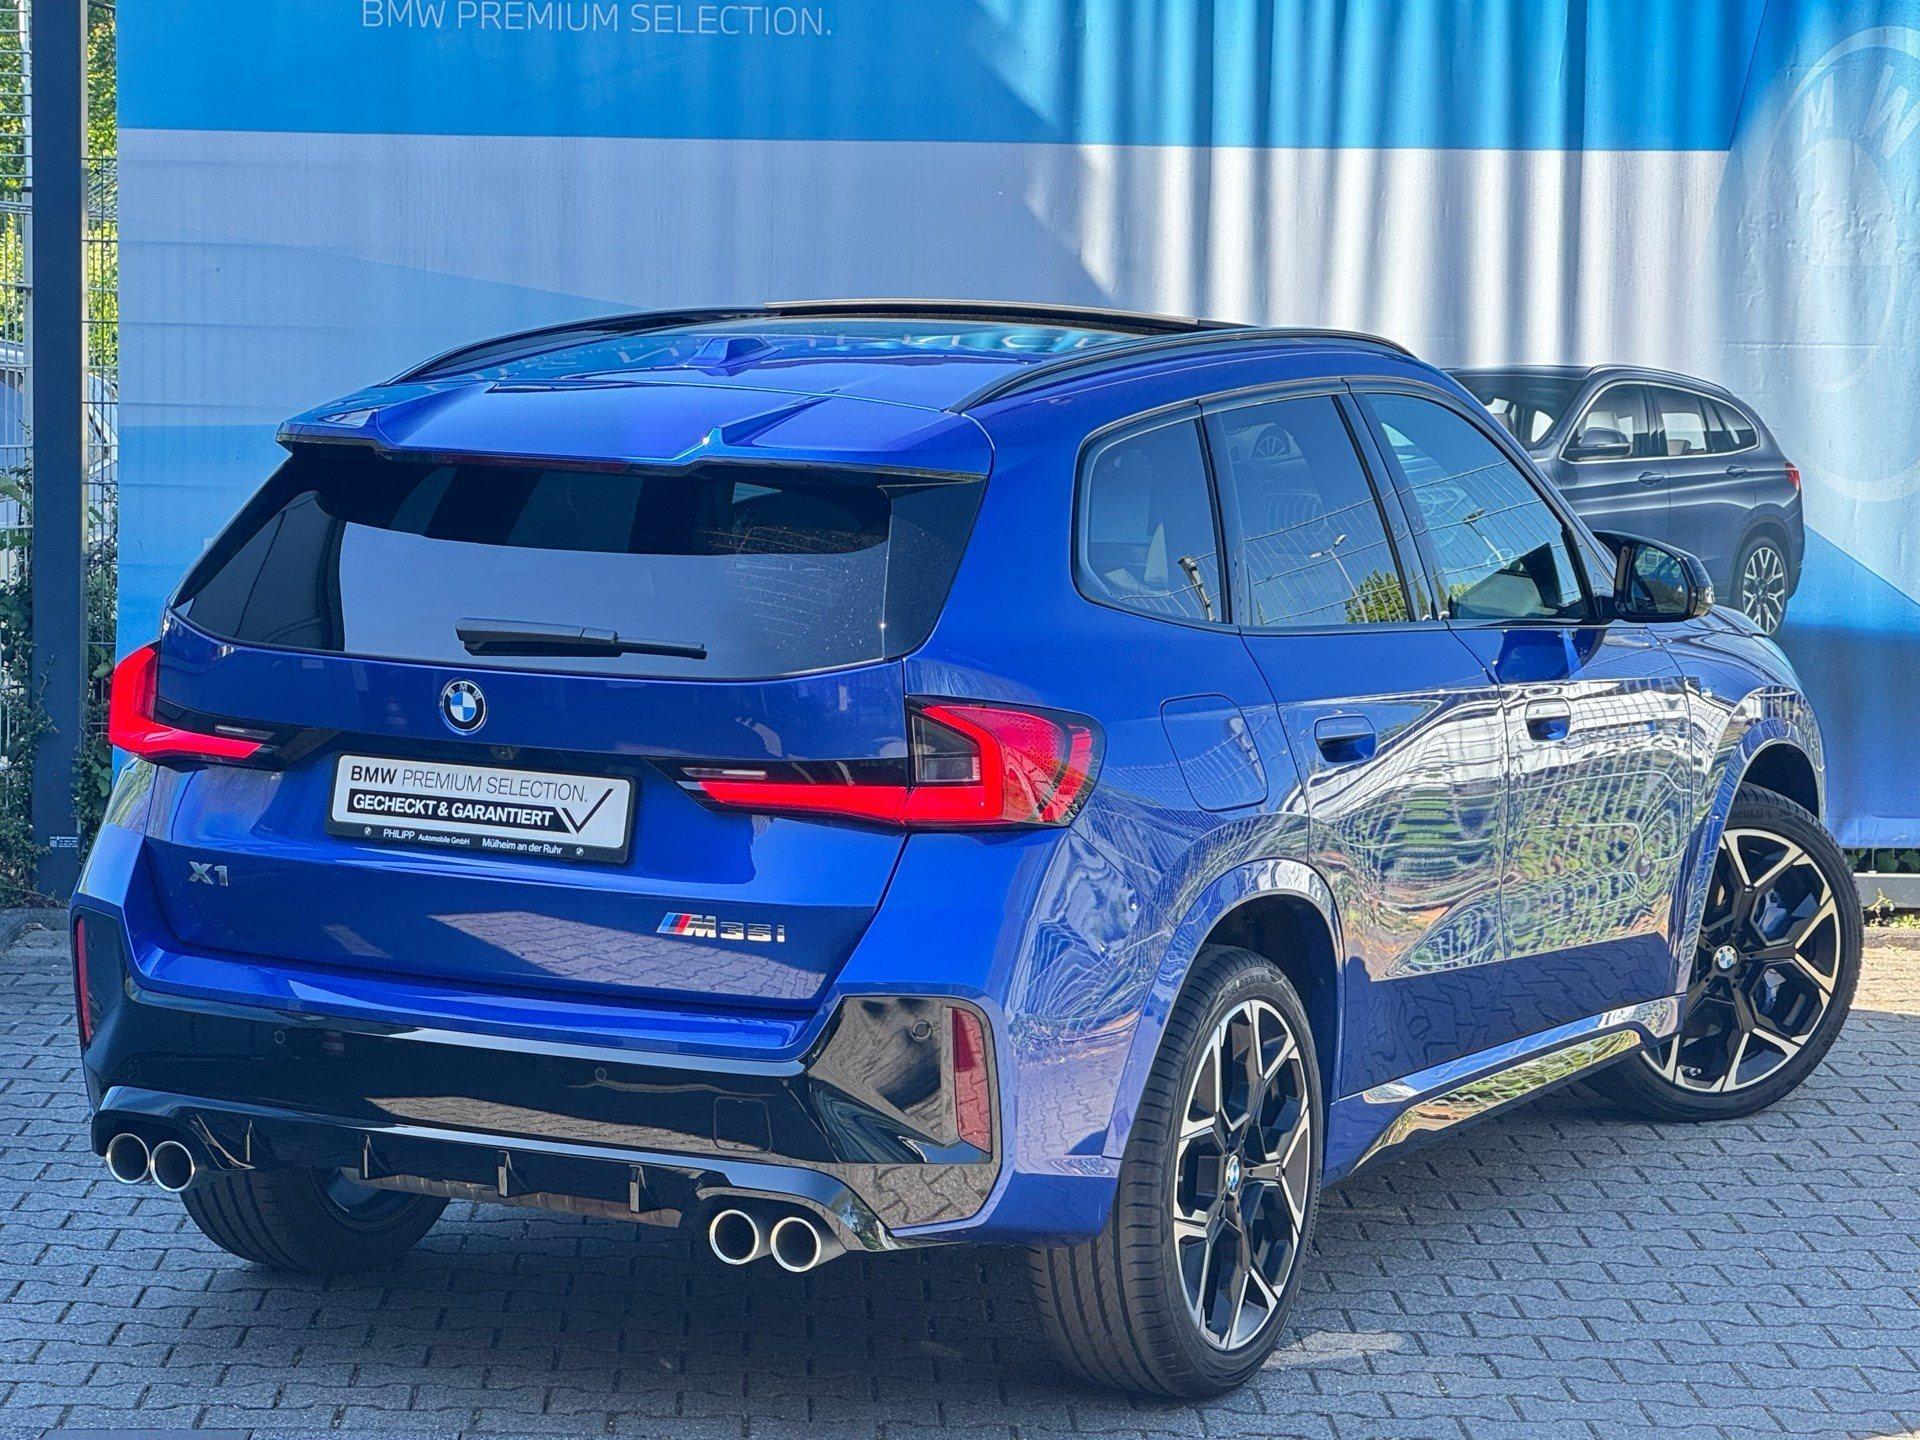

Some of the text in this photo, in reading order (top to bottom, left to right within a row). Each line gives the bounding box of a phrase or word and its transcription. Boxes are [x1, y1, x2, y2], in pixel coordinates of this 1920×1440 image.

[362, 0, 832, 36] BMW PREMIUM SELECTION.
[350, 765, 588, 802] BMW PREMIUM SELECTION.
[353, 793, 554, 826] GECHECKT & GARANTIERT
[383, 828, 471, 845] PHILIPP Automobile GmbH
[482, 838, 563, 855] Mülheim an der Ruhr
[189, 861, 229, 887] X1
